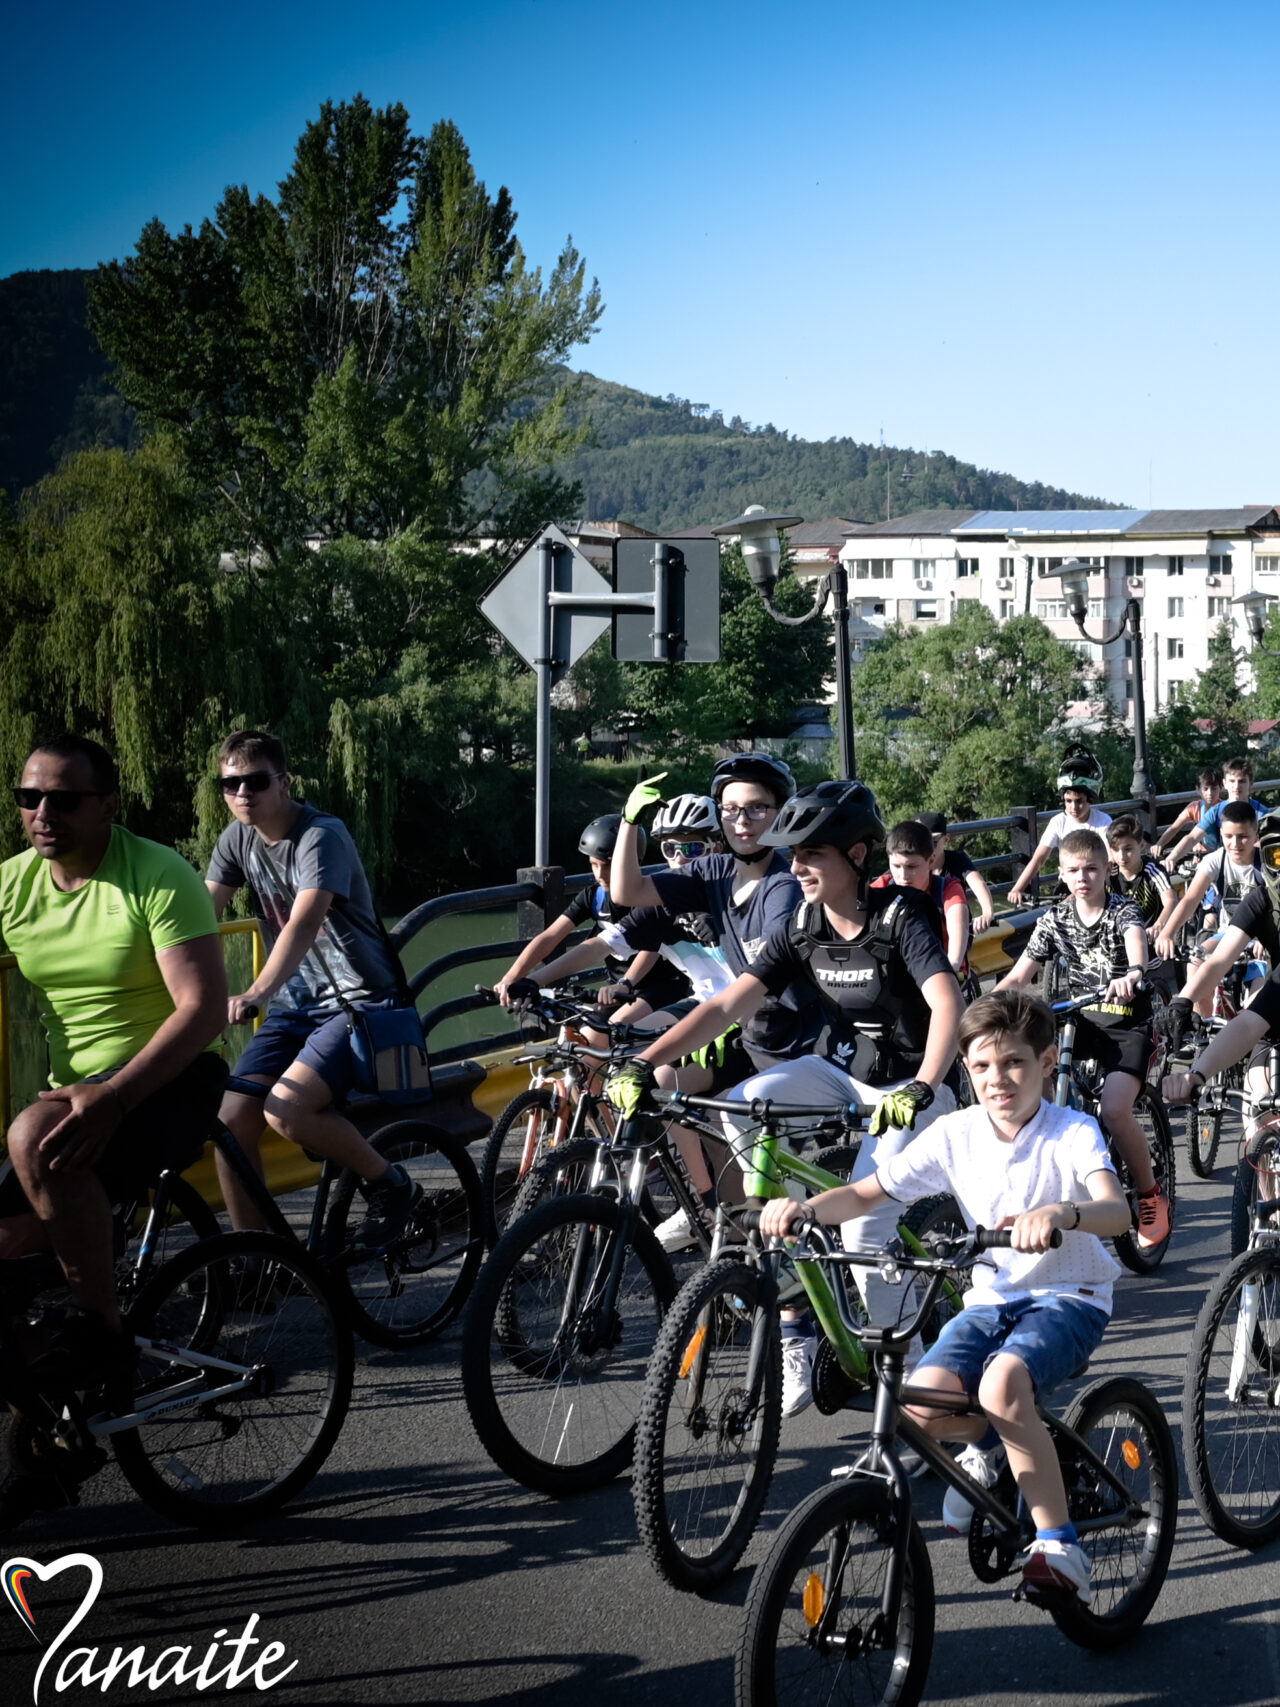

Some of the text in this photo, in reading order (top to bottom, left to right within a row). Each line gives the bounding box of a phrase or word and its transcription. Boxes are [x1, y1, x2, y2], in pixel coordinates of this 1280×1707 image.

[816, 968, 875, 982] THOR
[827, 981, 868, 989] RACING
[1101, 1003, 1133, 1017] BATMAN
[158, 1395, 200, 1416] DUNLOP
